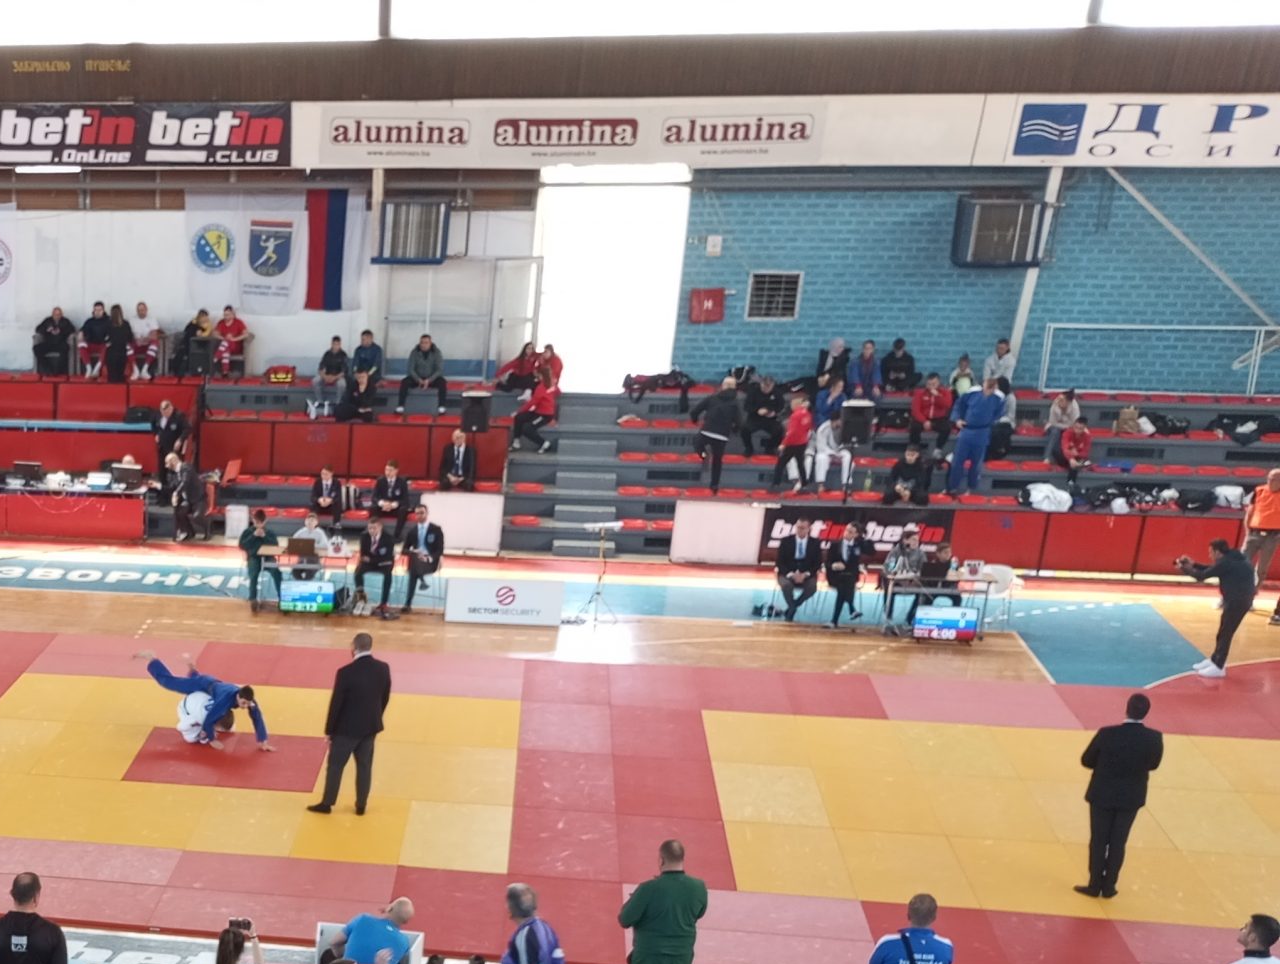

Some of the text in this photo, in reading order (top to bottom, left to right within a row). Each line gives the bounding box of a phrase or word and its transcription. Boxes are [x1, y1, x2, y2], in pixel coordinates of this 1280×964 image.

[0, 109, 137, 146] betin
[148, 110, 285, 146] betin
[332, 120, 468, 145] alumina
[495, 120, 636, 146] alumina
[664, 117, 810, 143] alumina
[770, 519, 847, 541] btin
